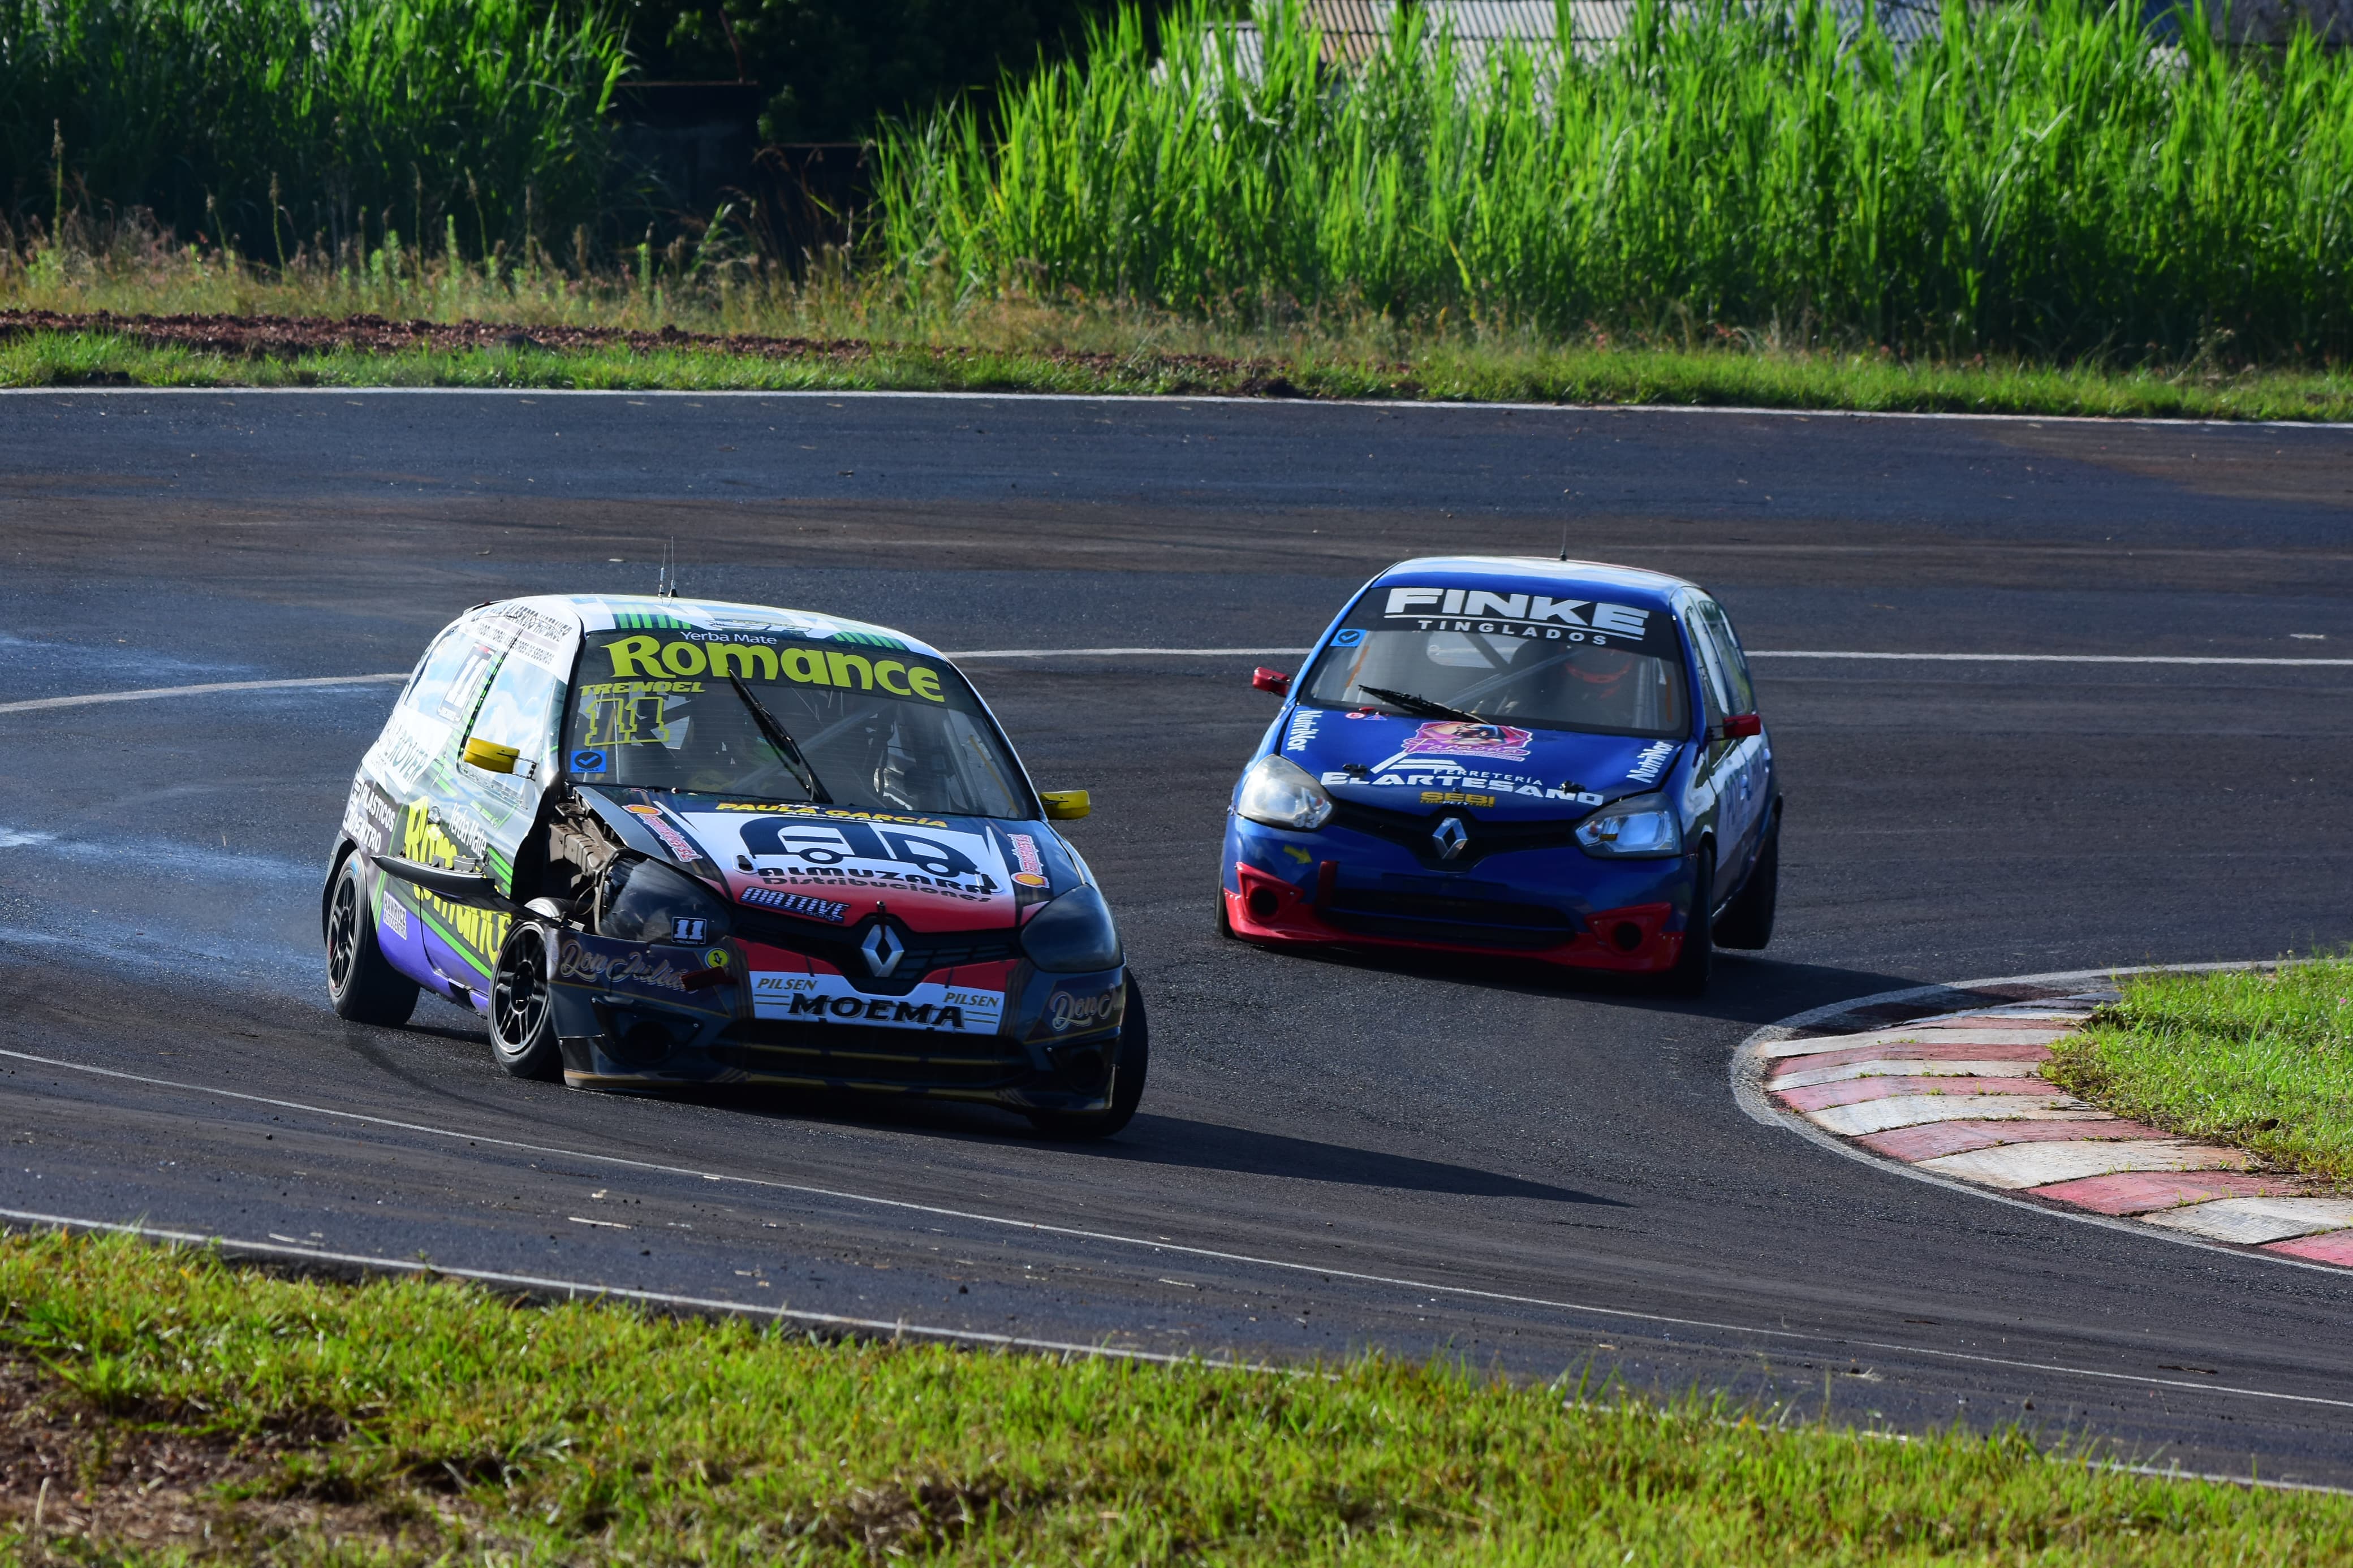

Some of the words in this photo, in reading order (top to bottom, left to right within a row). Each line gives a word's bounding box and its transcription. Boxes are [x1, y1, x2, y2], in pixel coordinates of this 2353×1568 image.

[1385, 588, 1650, 635] FINKE
[681, 631, 730, 643] Yerba
[734, 633, 777, 645] Mate
[1419, 620, 1607, 646] TINGLADOS
[445, 654, 489, 709] 11
[601, 634, 945, 702] Romance
[579, 681, 706, 695] TRENDEL
[1286, 710, 1324, 751] NutriNor
[1626, 741, 1674, 784] NutriNor
[1433, 768, 1544, 786] FERRETERÍA
[360, 783, 396, 833] PLASTICOS
[1420, 792, 1496, 807] SEBI
[716, 802, 817, 814] PAULA
[825, 809, 948, 828] GARCÍA
[1293, 813, 1319, 829] 33
[348, 813, 382, 853] CENTRO
[449, 803, 469, 843] Yerba
[468, 819, 488, 860] Mate
[758, 867, 994, 895] ALMUZARA
[762, 877, 992, 903] Distribuciones
[673, 919, 704, 940] 11
[801, 910, 835, 922] racing
[561, 939, 607, 982] Don
[756, 978, 817, 991] PILSEN
[787, 994, 965, 1029] MOEMA
[943, 992, 999, 1008] PILSEN
[1049, 991, 1097, 1031] Don
